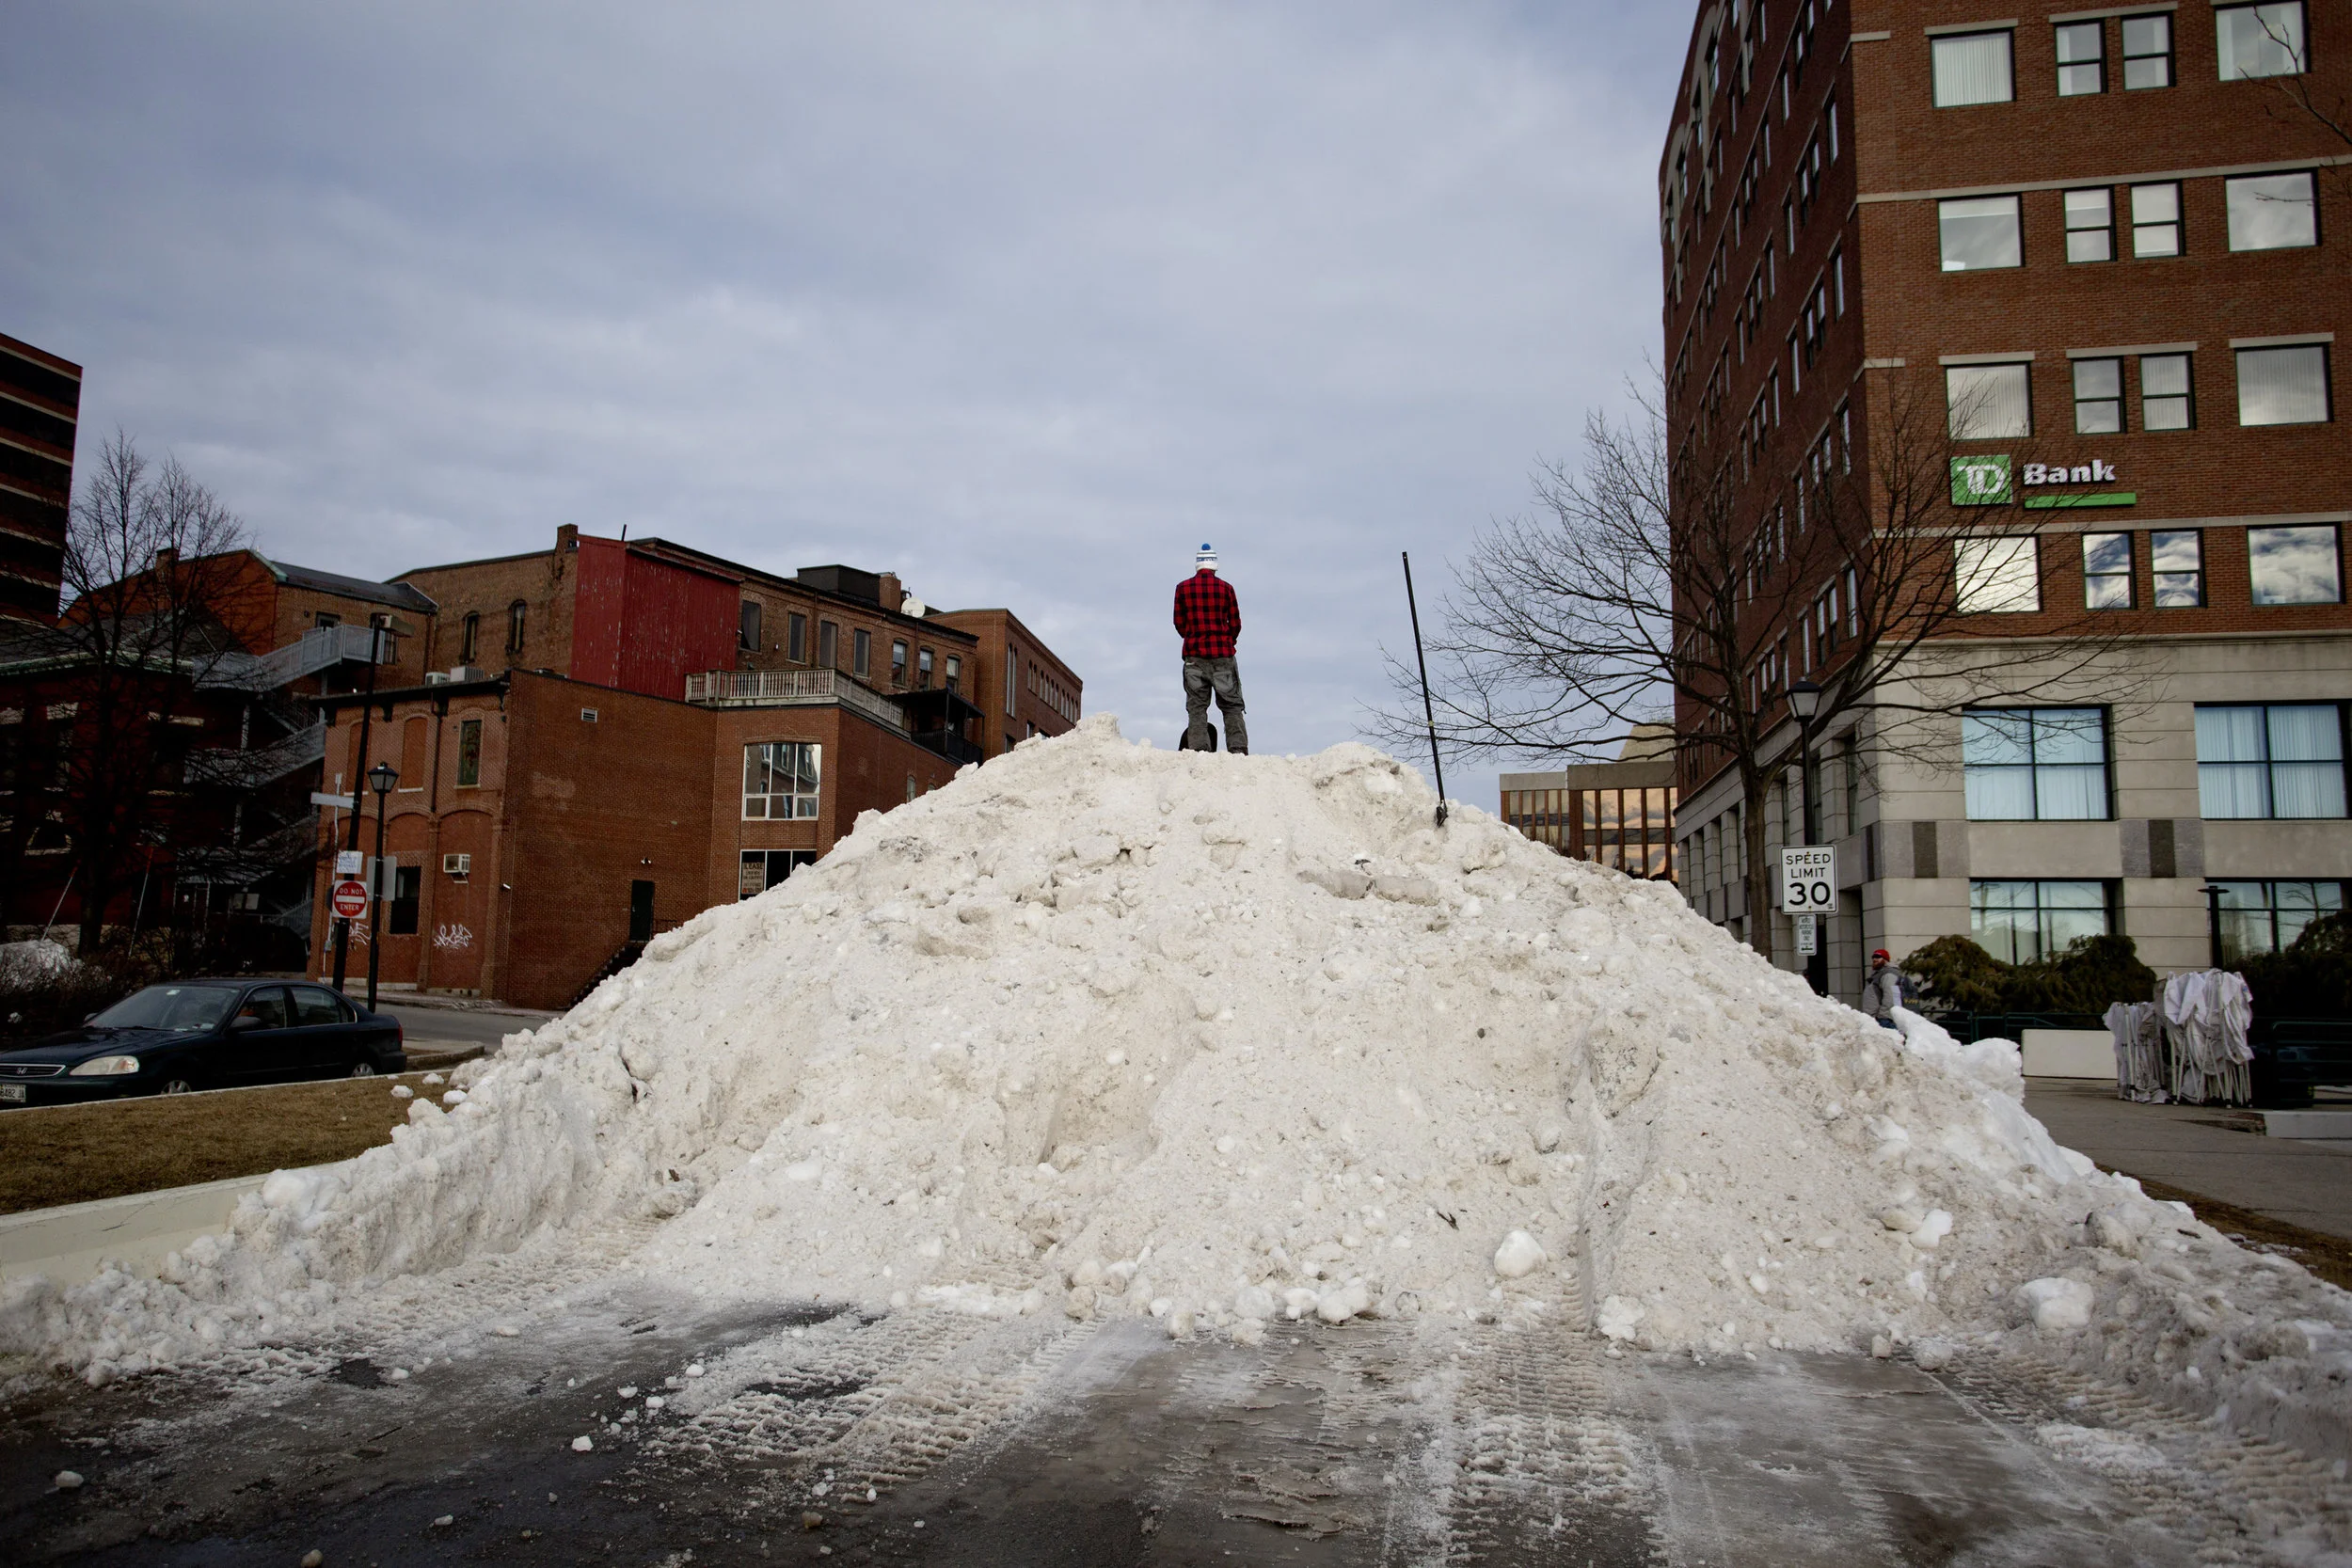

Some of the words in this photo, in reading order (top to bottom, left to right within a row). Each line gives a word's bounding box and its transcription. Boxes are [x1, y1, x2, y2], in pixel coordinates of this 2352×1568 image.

[1957, 465, 2006, 494] TD
[2024, 459, 2116, 485] Bank
[1786, 853, 1831, 864] SPEED
[1790, 867, 1826, 879] LIMIT
[1788, 881, 1831, 906] 30
[340, 903, 359, 911] ENTER
